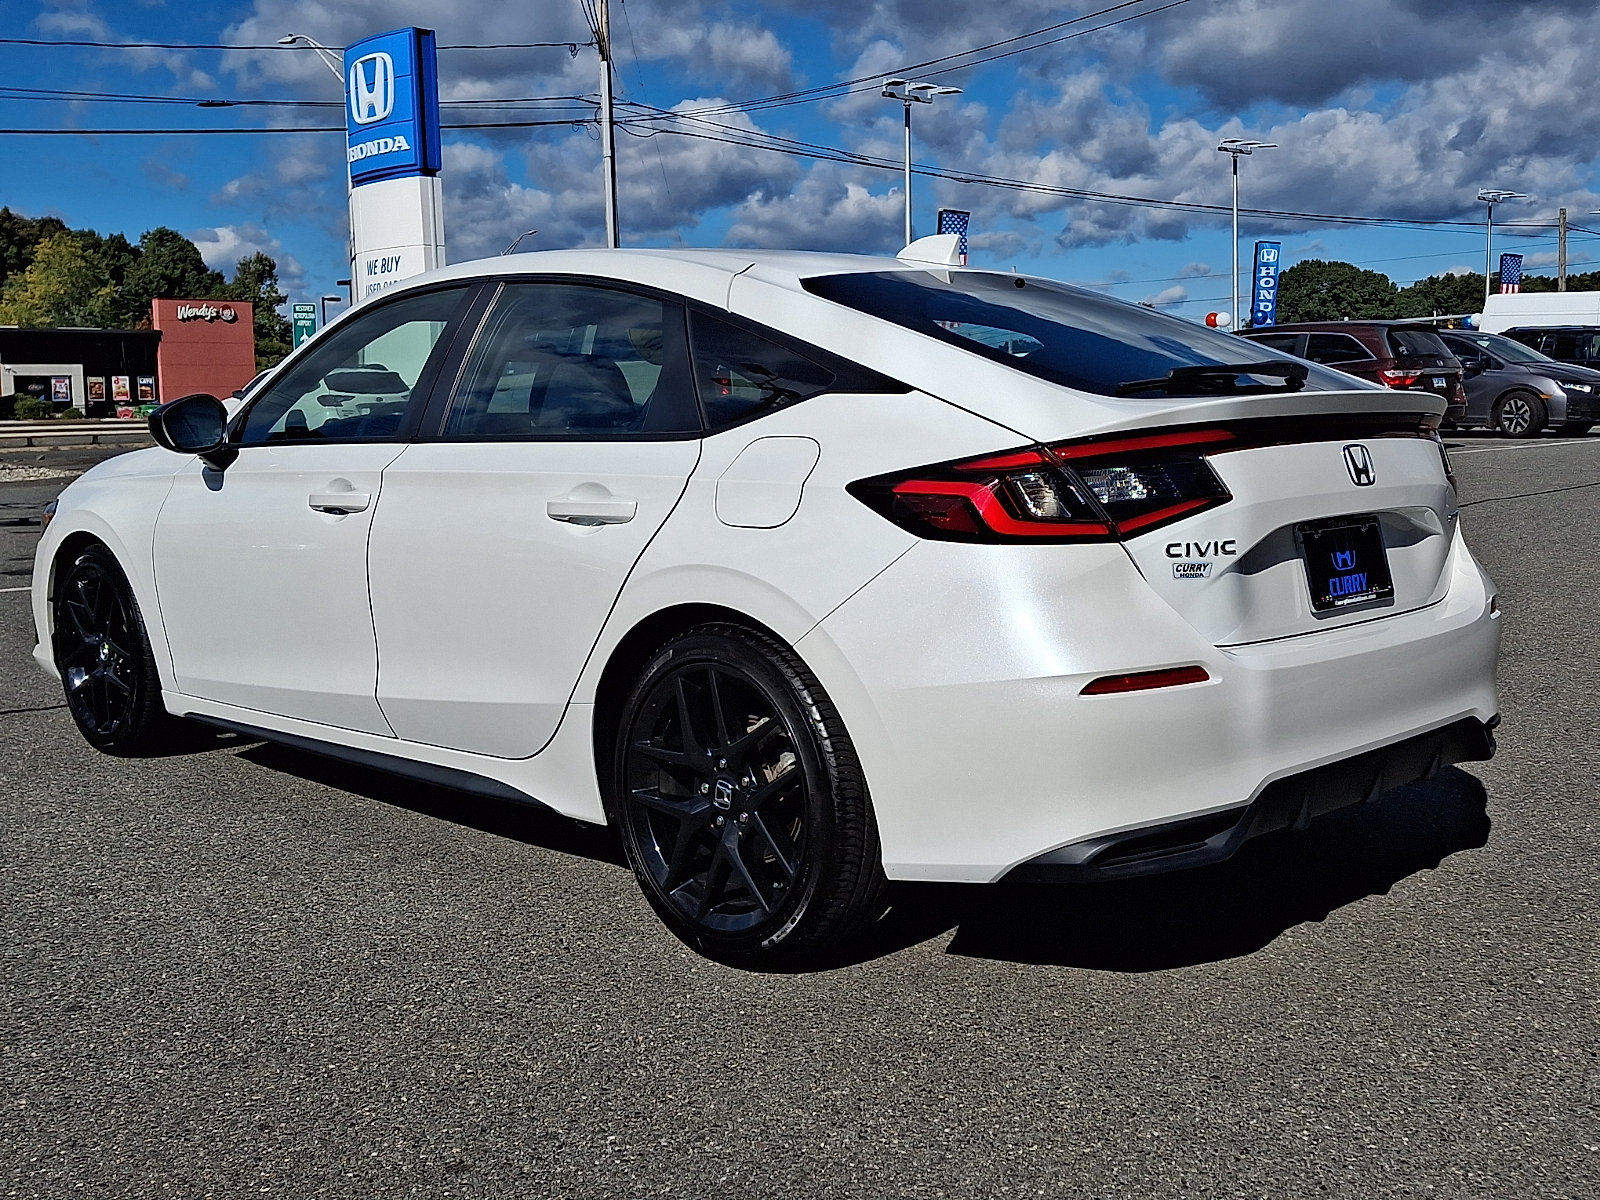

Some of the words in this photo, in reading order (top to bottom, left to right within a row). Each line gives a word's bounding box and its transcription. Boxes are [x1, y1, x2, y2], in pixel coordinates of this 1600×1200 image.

[349, 135, 411, 163] HONDA
[366, 259, 379, 276] WE
[380, 255, 401, 274] BUY
[177, 303, 217, 320] Wendy's
[1164, 539, 1238, 559] CIVIC
[1175, 563, 1210, 573] CURRY
[1329, 572, 1368, 597] CURRY
